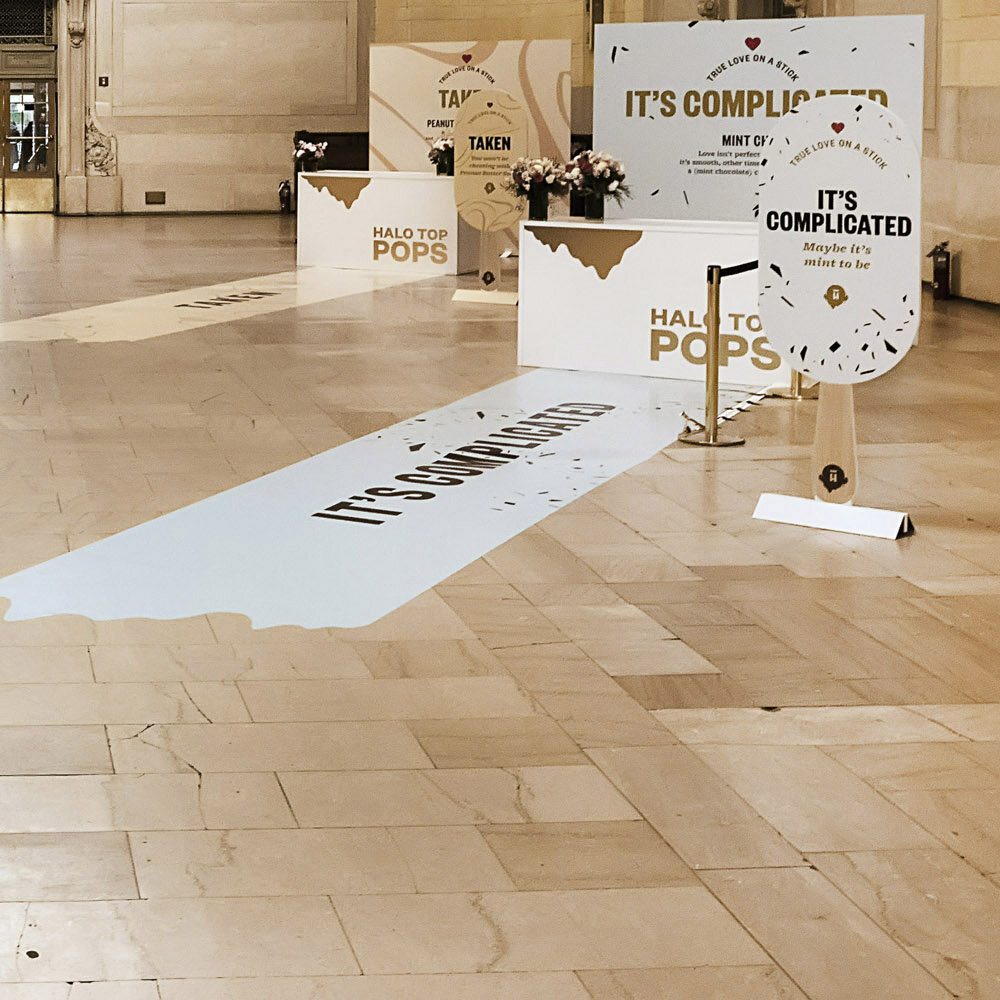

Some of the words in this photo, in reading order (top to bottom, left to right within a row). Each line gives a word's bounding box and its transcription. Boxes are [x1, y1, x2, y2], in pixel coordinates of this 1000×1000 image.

[439, 71, 451, 84] TRUE
[452, 66, 465, 74] LOVE
[481, 69, 495, 84] STICK
[706, 63, 727, 81] TRUE
[728, 55, 750, 66] LOVE
[753, 54, 766, 62] ON
[767, 57, 774, 65] A
[776, 61, 799, 82] STICK
[438, 89, 481, 108] TAK
[626, 90, 676, 117] IT'S
[684, 89, 888, 117] COMPLICD
[427, 120, 454, 128] PEANUT
[468, 136, 511, 151] TAKEN
[722, 135, 751, 146] MINT
[790, 147, 811, 167] TRUE
[812, 139, 835, 152] LOVE
[839, 139, 853, 148] ON
[854, 143, 861, 151] A
[862, 147, 888, 170] STICK
[818, 189, 858, 211] IT'S
[373, 226, 413, 239] HALO
[417, 228, 448, 240] TOP
[766, 210, 912, 237] COMPLICATED
[373, 240, 448, 264] POPS
[803, 242, 847, 255] Maybe
[850, 244, 872, 255] it's
[804, 257, 836, 268] mint
[839, 259, 851, 269] to
[855, 259, 871, 270] be
[650, 329, 781, 371] POPS
[311, 486, 436, 525] IT'S
[394, 402, 616, 486] COMPLICATED
